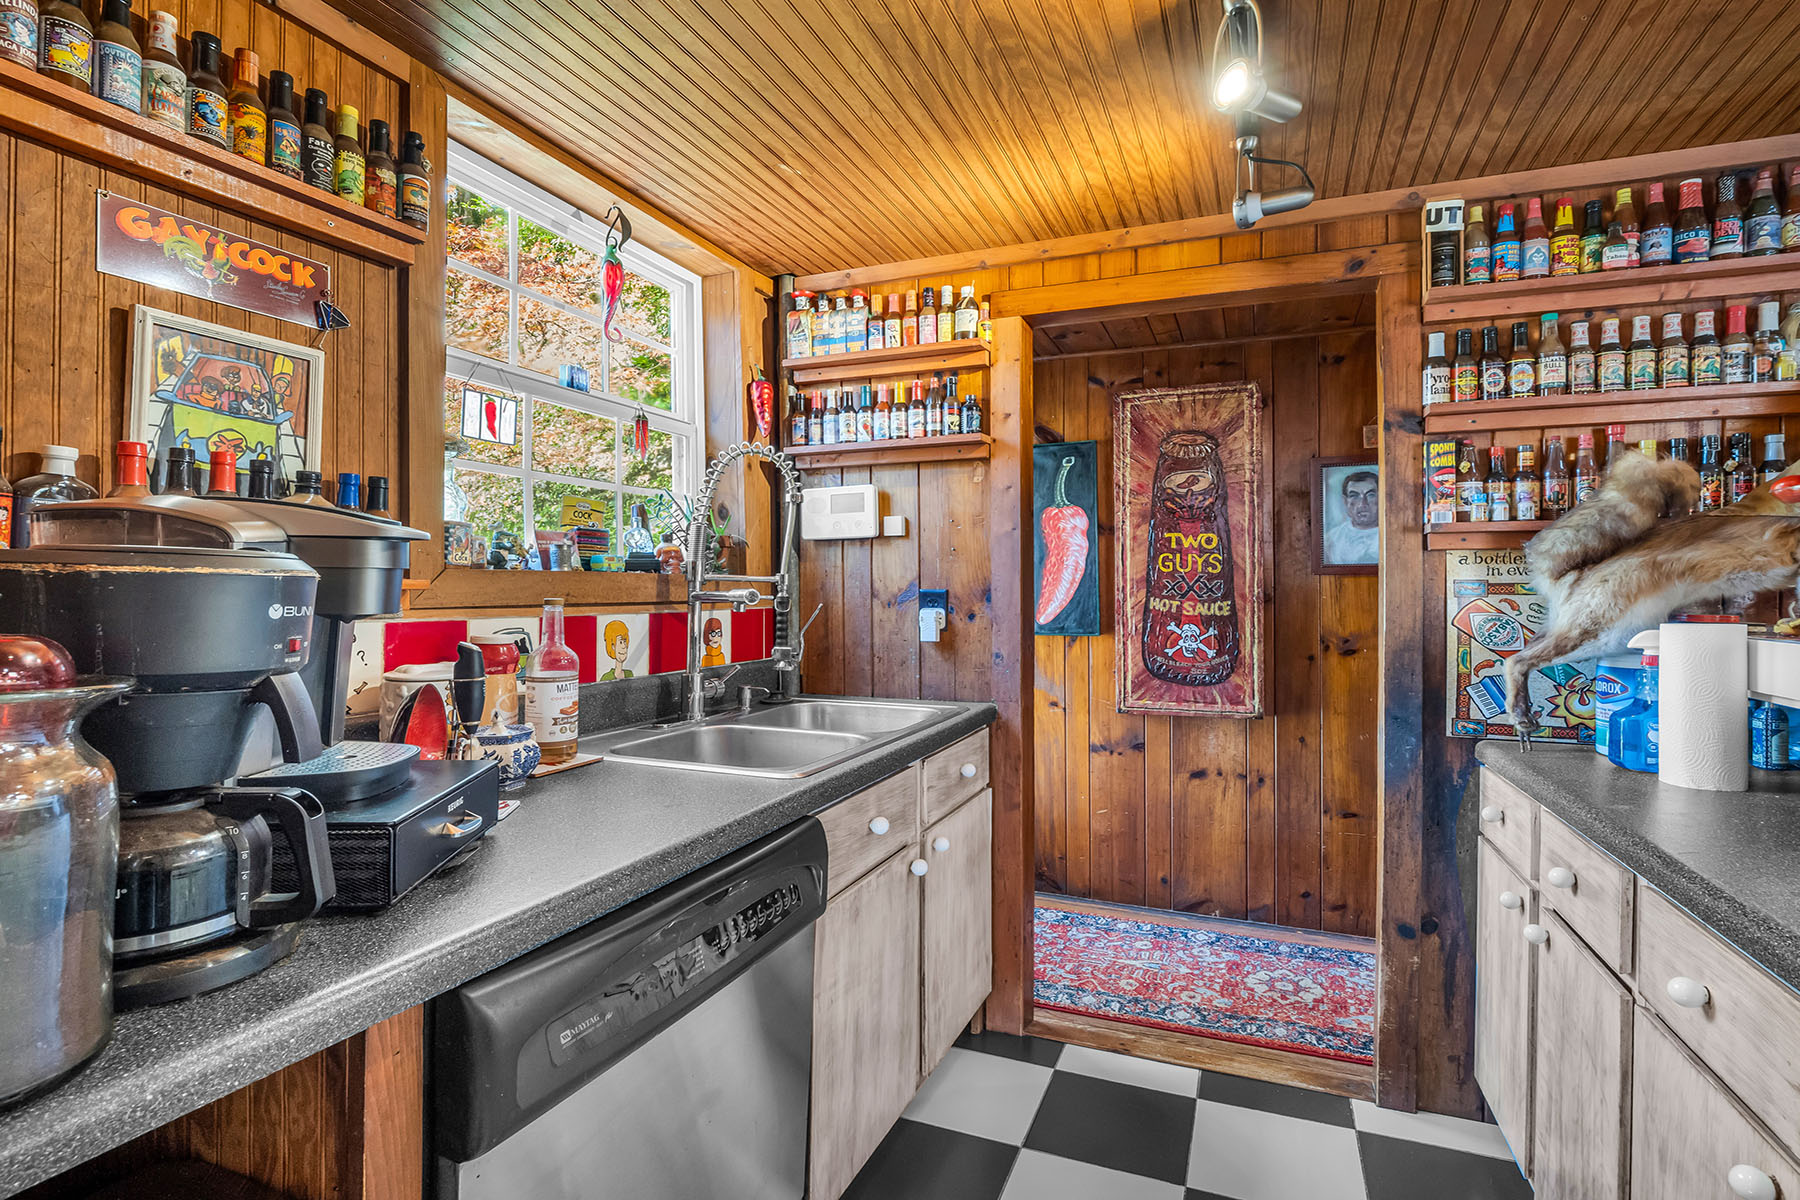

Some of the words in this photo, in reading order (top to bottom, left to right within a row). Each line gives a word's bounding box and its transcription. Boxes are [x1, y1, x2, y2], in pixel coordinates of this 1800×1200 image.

[0, 0, 38, 18] ELIND
[0, 40, 18, 52] AGA
[101, 45, 125, 57] SOUTH
[308, 137, 325, 148] Fat
[1714, 227, 1740, 238] DEVIL
[115, 206, 211, 255] GAY
[228, 241, 316, 289] COCK
[1543, 361, 1562, 369] BULL
[572, 510, 593, 520] COCK
[1164, 532, 1218, 549] TWO
[1158, 552, 1223, 573] GUYS
[1458, 555, 1470, 565] a
[283, 605, 314, 617] BUN
[1149, 596, 1181, 613] HOT
[1182, 600, 1232, 616] SAUCE
[229, 827, 239, 835] 10
